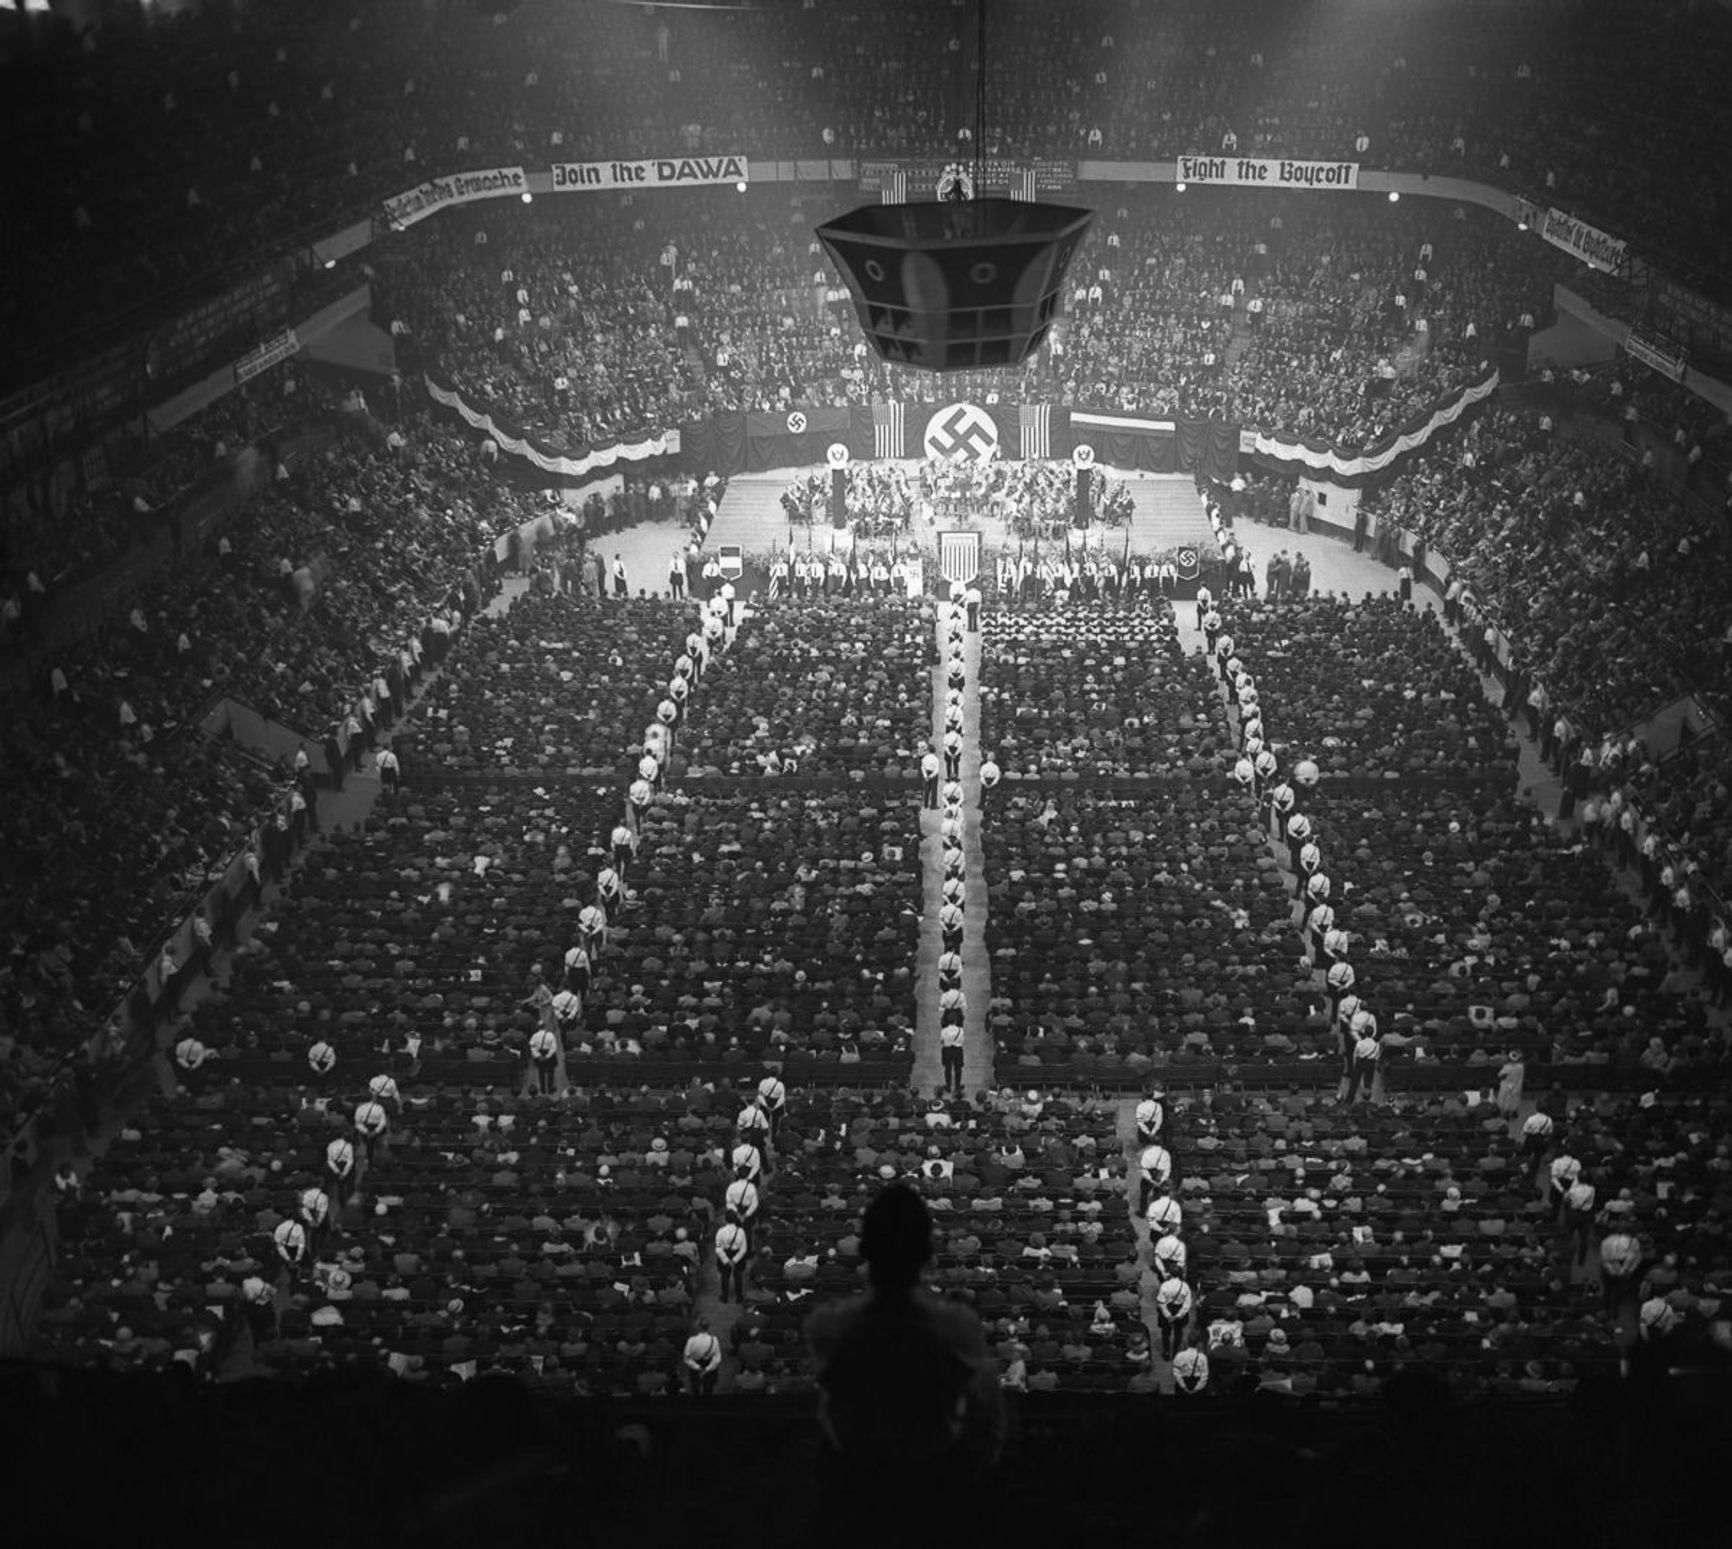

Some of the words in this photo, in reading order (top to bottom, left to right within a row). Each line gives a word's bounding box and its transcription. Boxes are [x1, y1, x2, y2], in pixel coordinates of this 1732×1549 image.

[555, 165, 601, 185] Join
[611, 163, 645, 182] the
[1179, 157, 1226, 181] Fight
[1237, 160, 1268, 181] the
[1279, 161, 1352, 186] Boycott
